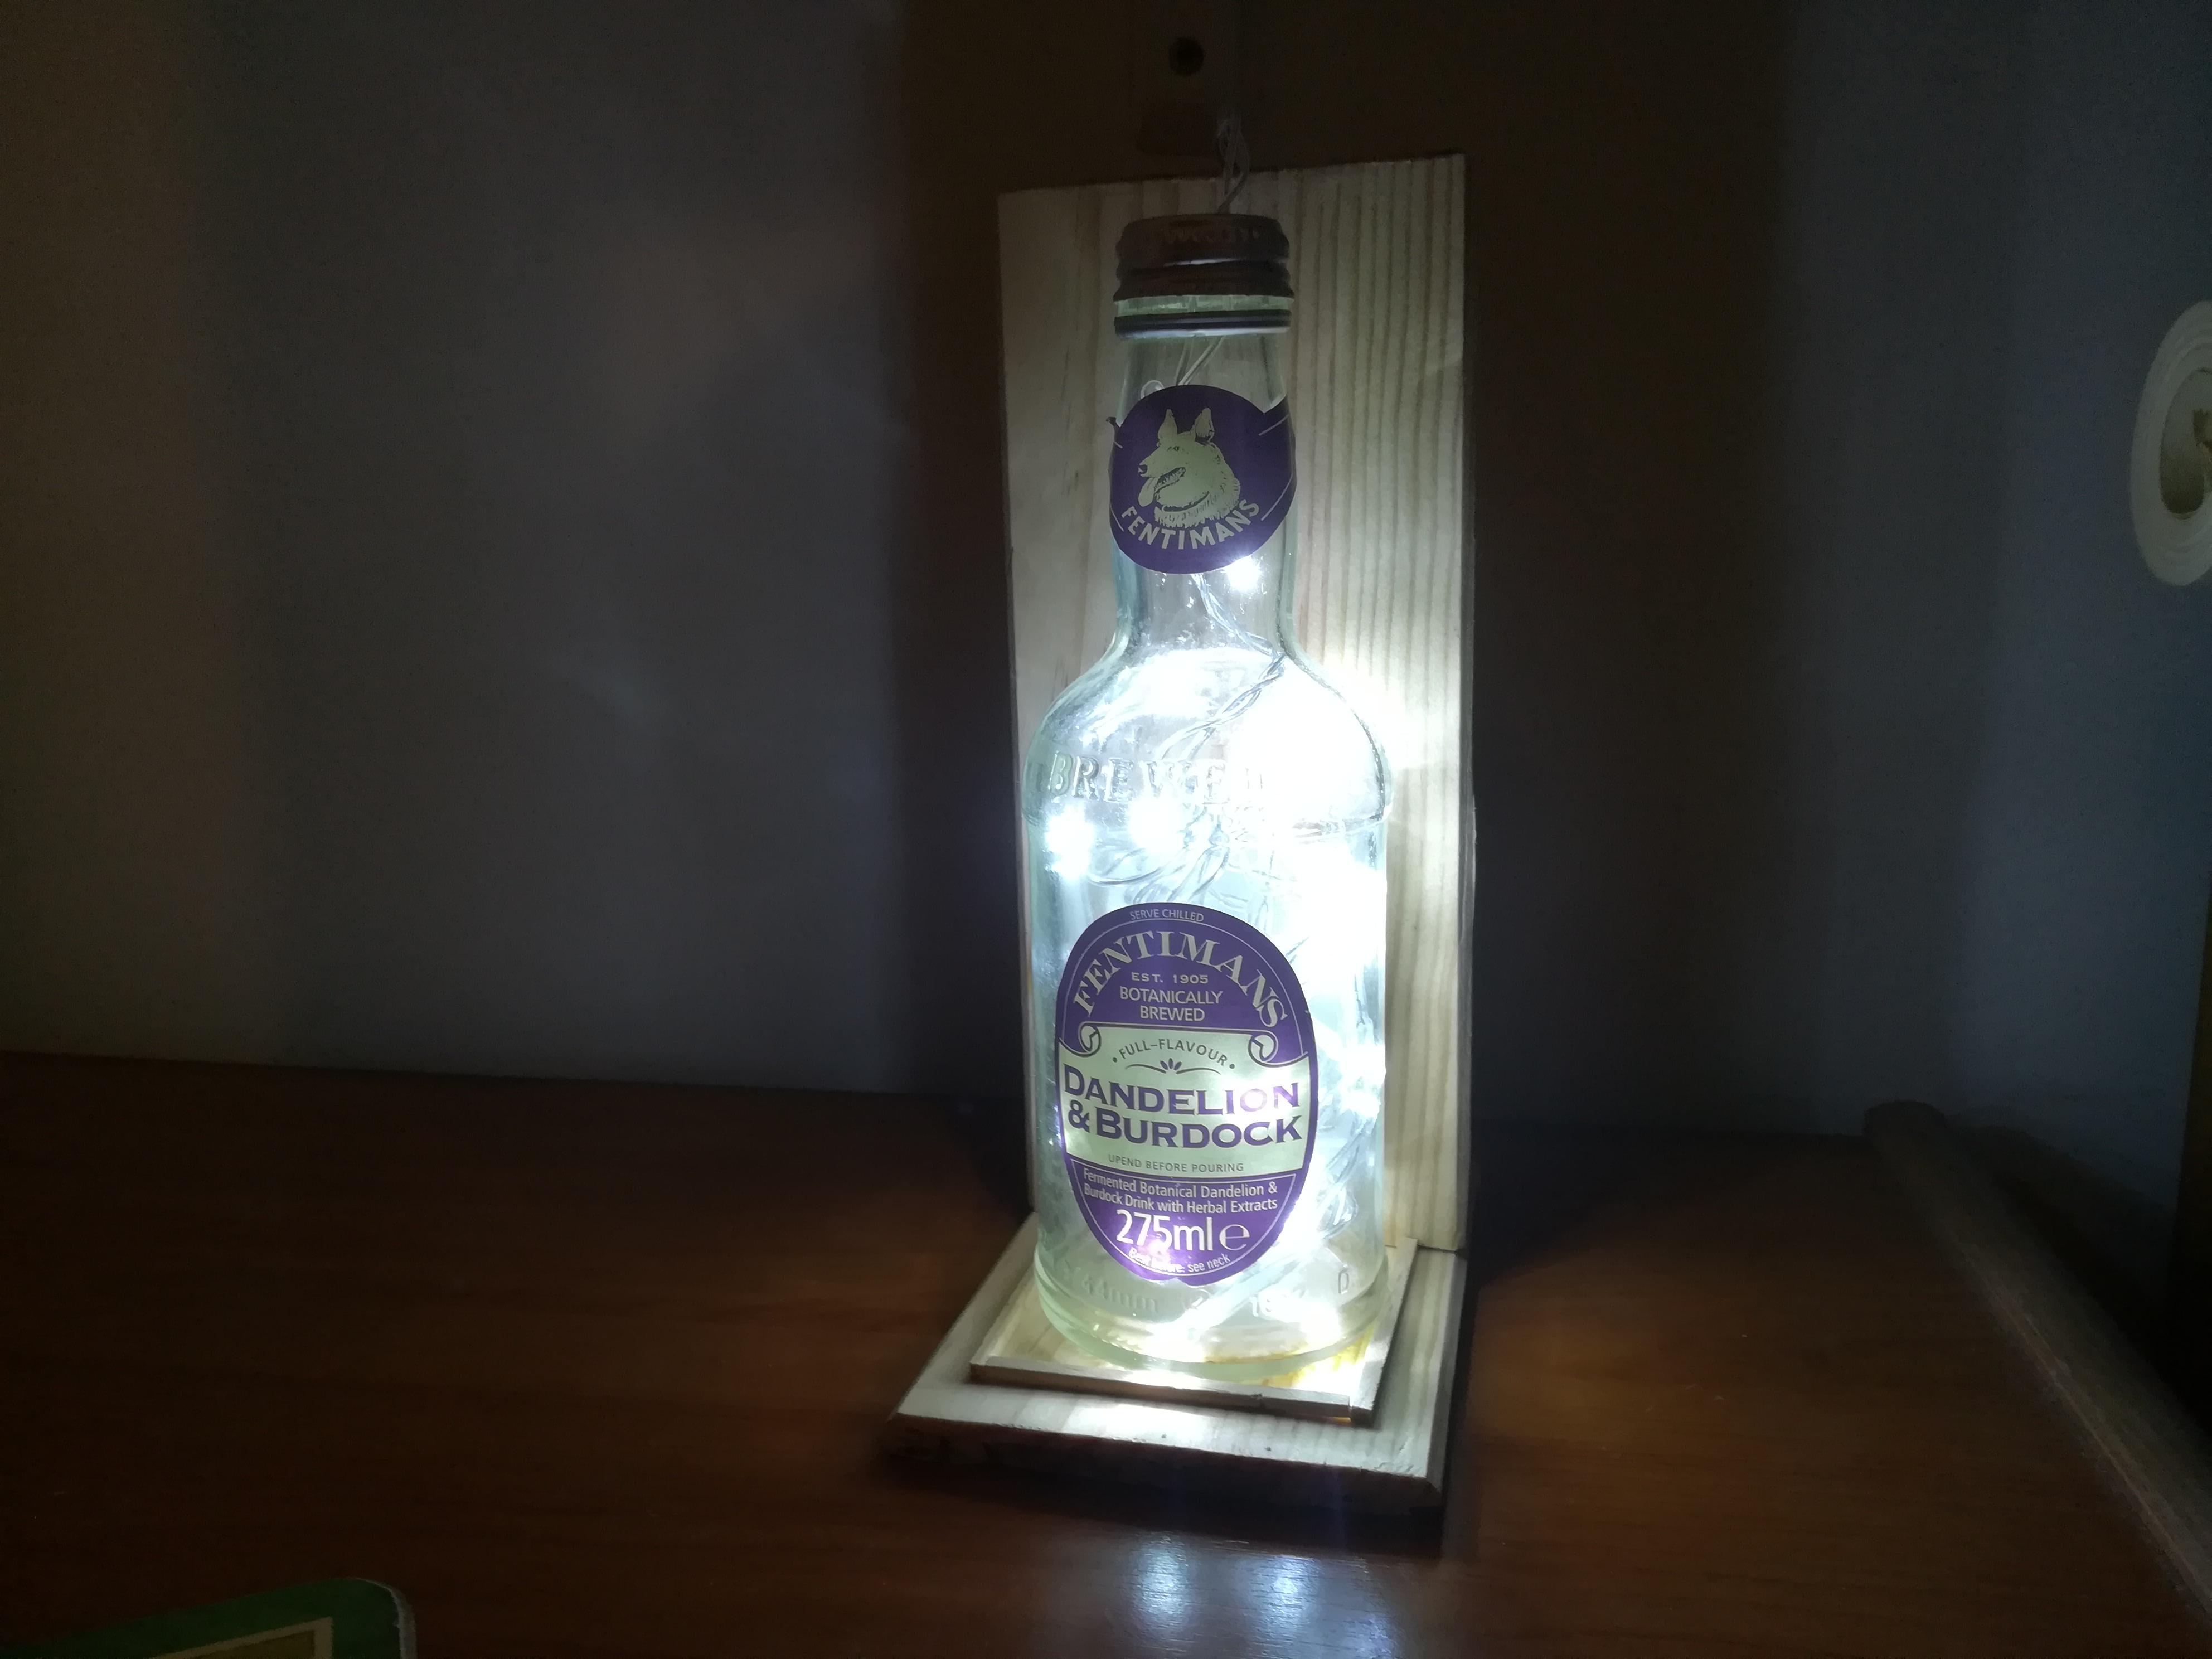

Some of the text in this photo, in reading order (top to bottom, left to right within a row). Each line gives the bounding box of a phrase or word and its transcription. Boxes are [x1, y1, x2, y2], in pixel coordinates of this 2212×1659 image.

[1122, 499, 1259, 549] FENTIMANS
[1129, 909, 1204, 921] SERVE CHILLED
[1073, 931, 1287, 1028] FENTIMANS
[1131, 972, 1209, 984] EST. 1905
[1119, 986, 1223, 1004] BOTANICALLY
[1140, 1005, 1205, 1022] BREWED
[1119, 1039, 1228, 1066] FULL-FLAVOUR
[1064, 1063, 1299, 1115] DANDELION
[1108, 1154, 1244, 1172] UPEND BEFORE POURING
[1083, 1167, 1278, 1199] Fermented Botanical Dandelion &
[1084, 1182, 1278, 1213] Burdock Drink with Herbal Extracts
[1117, 1209, 1213, 1251] 275ml
[1152, 1256, 1185, 1273] bore:
[1188, 1262, 1205, 1273] see
[1207, 1253, 1231, 1269] neck
